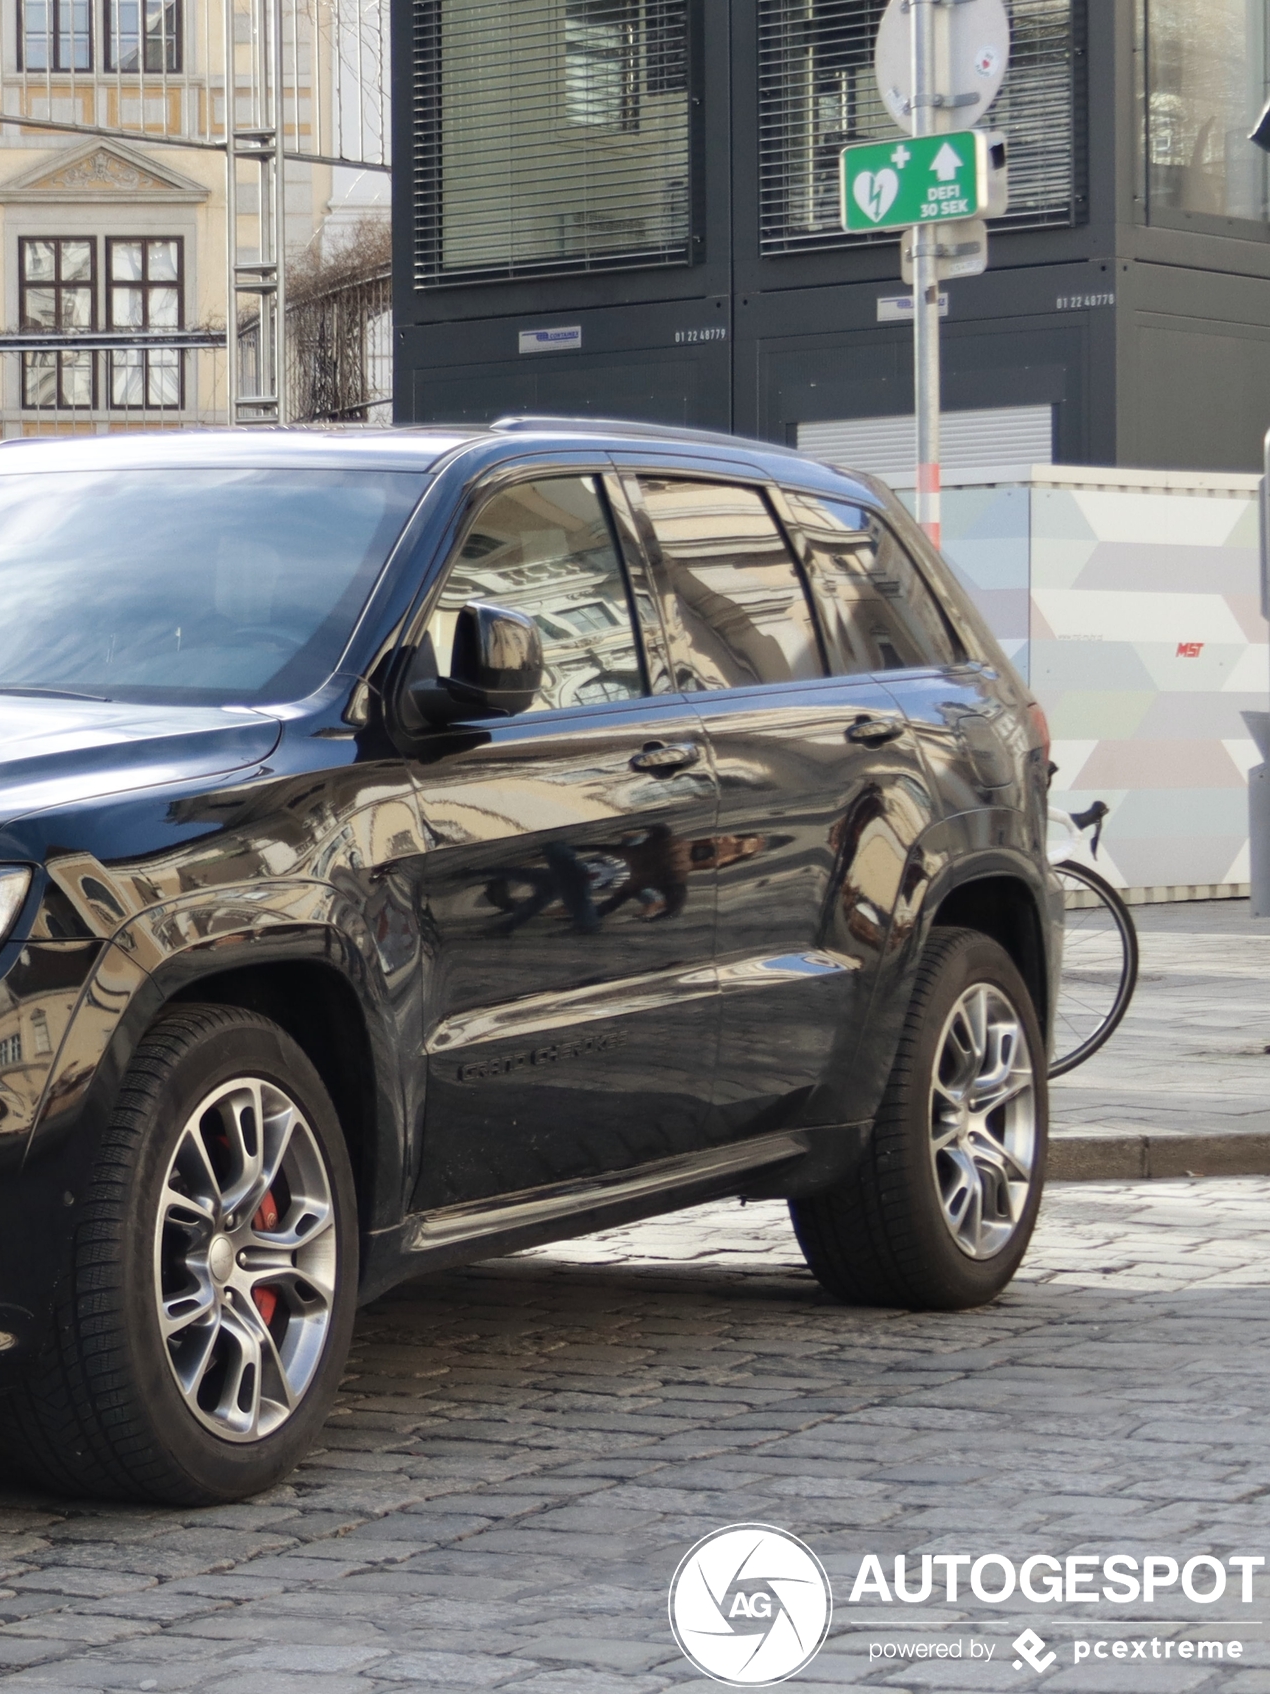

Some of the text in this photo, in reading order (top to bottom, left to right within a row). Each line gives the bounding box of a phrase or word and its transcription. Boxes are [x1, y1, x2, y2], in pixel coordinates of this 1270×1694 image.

[927, 185, 960, 201] DEFI
[920, 199, 969, 218] 30 SEK
[674, 328, 726, 343] 01 22 48779
[1175, 642, 1205, 658] MST
[458, 1030, 629, 1081] GRAND CHEROKEE
